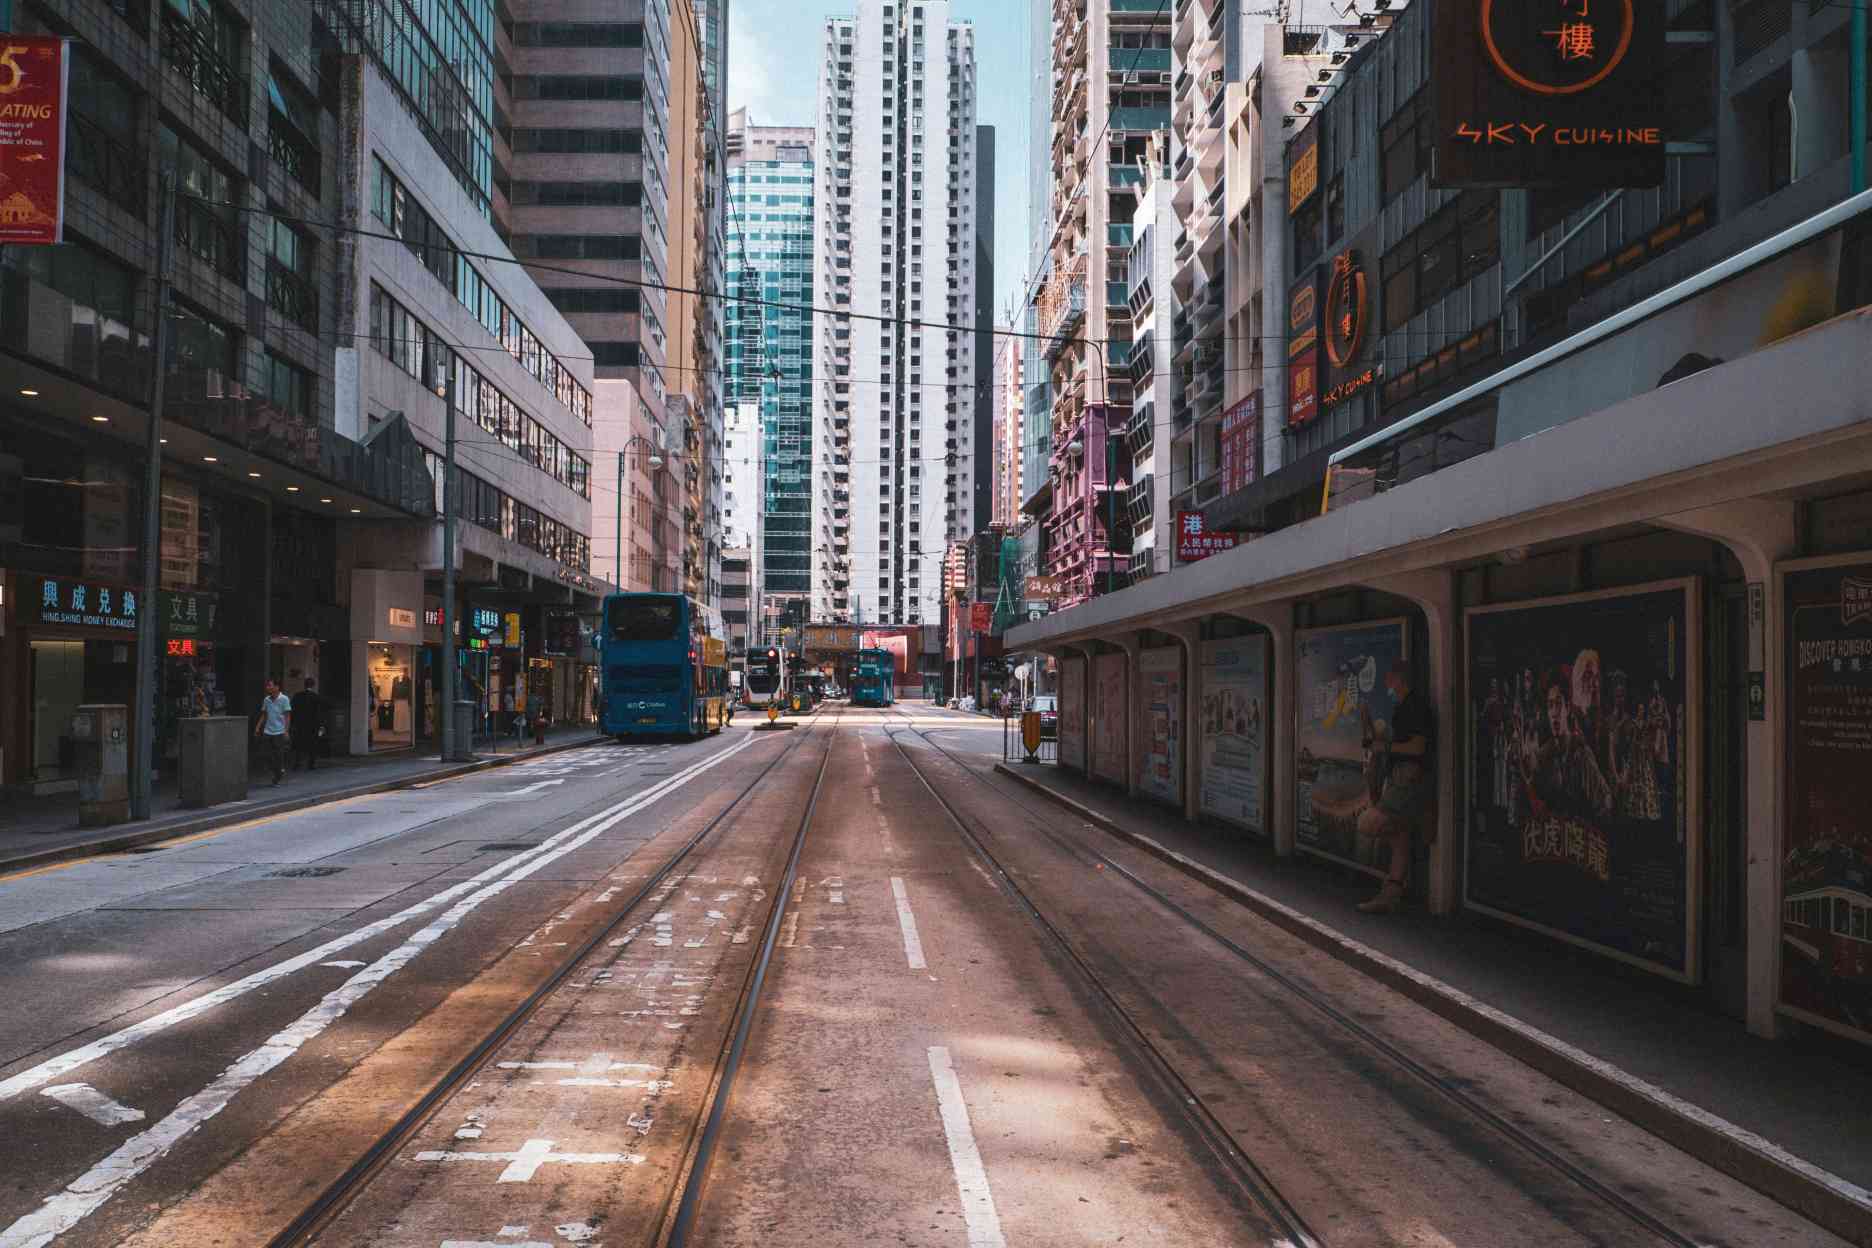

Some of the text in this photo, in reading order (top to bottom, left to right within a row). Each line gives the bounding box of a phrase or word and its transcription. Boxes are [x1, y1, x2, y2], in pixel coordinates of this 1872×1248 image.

[0, 103, 51, 119] ATING
[1456, 121, 1662, 145] SKY CUISINE
[1183, 514, 1203, 535] 港
[169, 596, 199, 623] 文具
[167, 640, 194, 656] 文具
